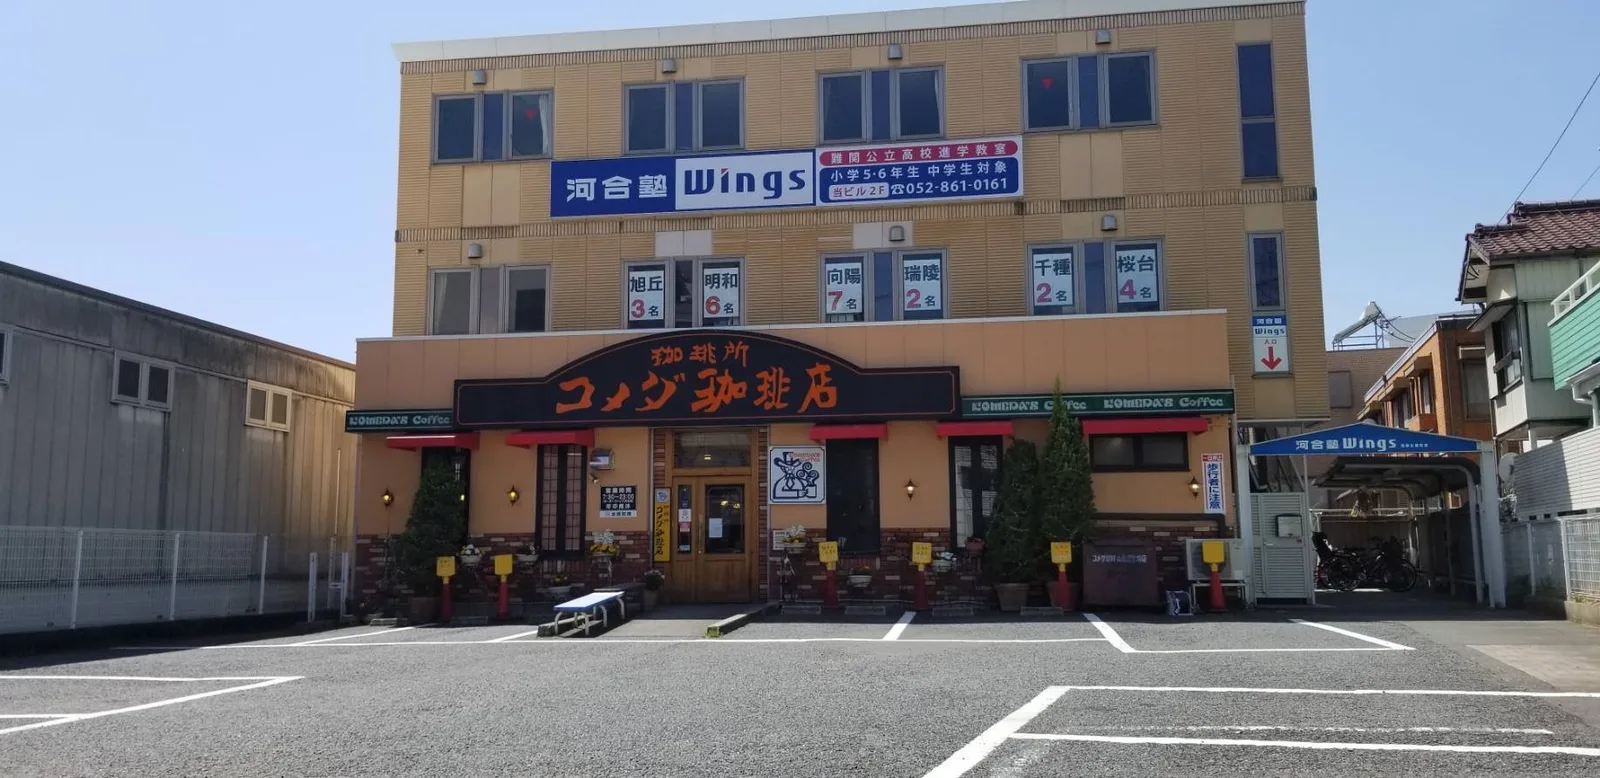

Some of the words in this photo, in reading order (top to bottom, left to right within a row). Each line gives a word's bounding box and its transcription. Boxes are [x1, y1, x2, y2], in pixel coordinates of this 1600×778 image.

[831, 143, 1007, 165] 難関公立高校進学教室
[928, 161, 1008, 178] 中学生対象
[567, 174, 667, 202] 河合塾
[685, 168, 806, 200] Wings
[906, 178, 1007, 195] 052-861-0161
[904, 264, 940, 282] 瑞陵
[1035, 258, 1072, 276] 千種
[1118, 255, 1155, 273] 桜台
[630, 276, 663, 293] 旭丘
[704, 272, 738, 290] 明和
[827, 268, 861, 285] 向陽
[651, 341, 749, 368] 珈琲所
[555, 362, 838, 414] コメダ珈琲店
[1179, 397, 1224, 407] Coffee
[412, 415, 450, 425] Coffee
[1296, 439, 1339, 450] 河合塾
[1342, 437, 1397, 451] Wings
